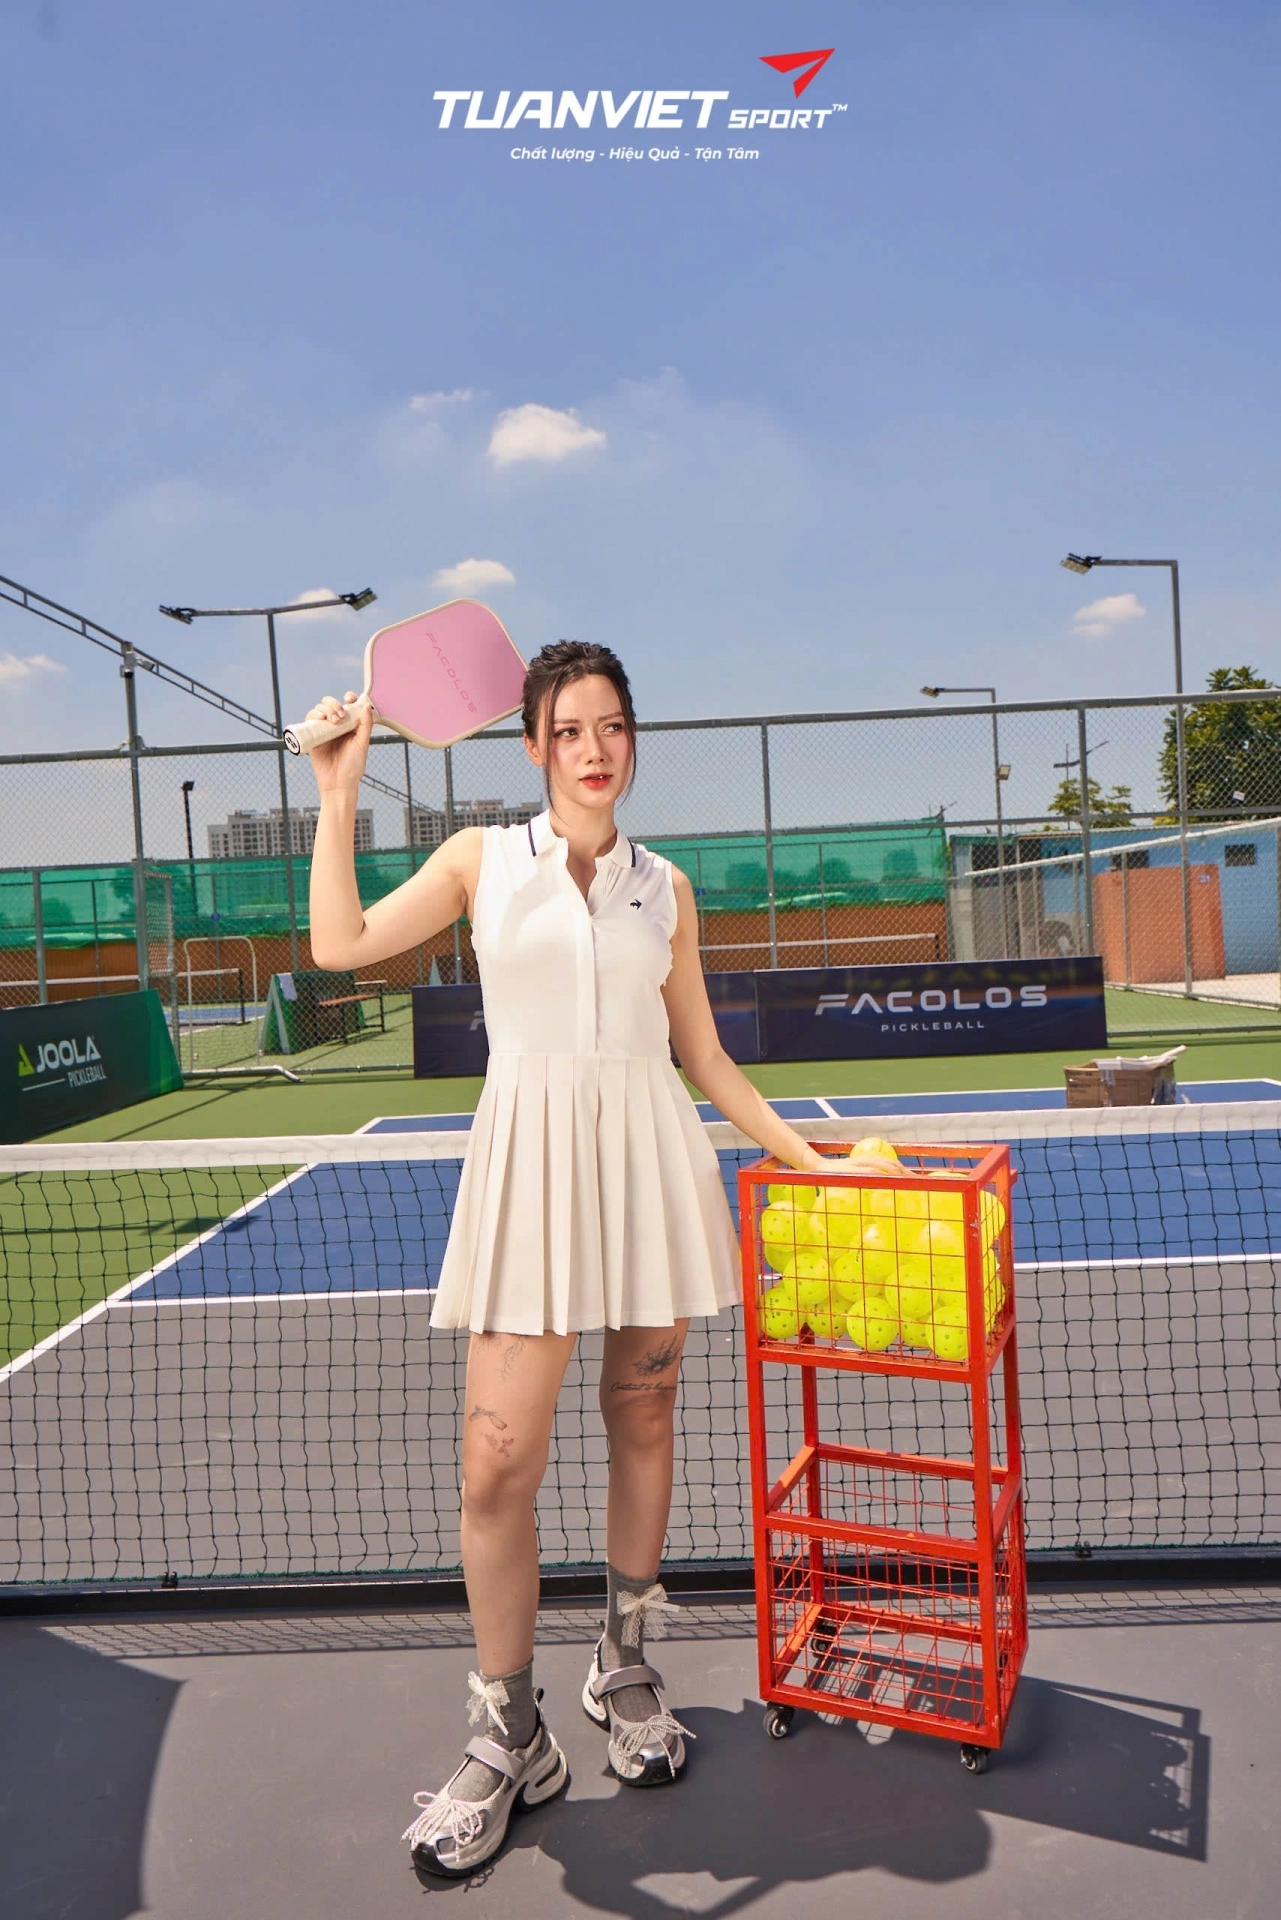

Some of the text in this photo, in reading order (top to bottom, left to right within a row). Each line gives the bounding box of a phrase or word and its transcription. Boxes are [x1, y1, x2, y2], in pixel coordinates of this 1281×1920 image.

[425, 632, 477, 713] FACOLOS
[815, 985, 1048, 1016] FACOLOS
[881, 1020, 985, 1033] PICKLEBALL
[37, 1036, 102, 1073] JOOLA
[67, 1064, 107, 1088] PICKLEBALL
